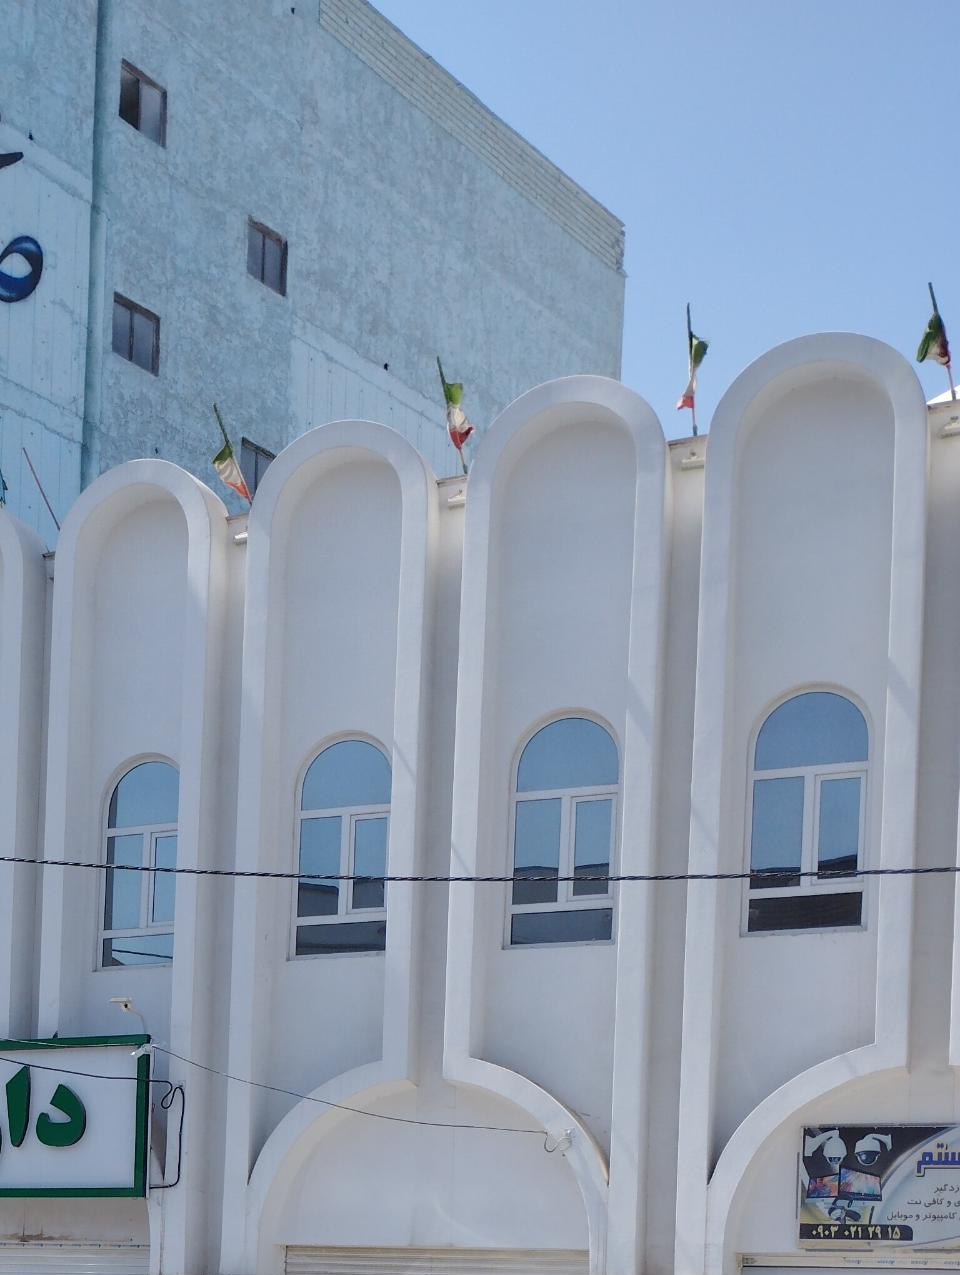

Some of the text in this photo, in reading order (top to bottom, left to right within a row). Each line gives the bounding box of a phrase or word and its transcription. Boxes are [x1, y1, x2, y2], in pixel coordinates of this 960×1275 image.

[924, 1198, 945, 1208] کافی
[886, 1211, 914, 1222] موبایل
[922, 1211, 958, 1223] کامپیوتر
[811, 1225, 839, 1239] ۰۹۰۳
[844, 1225, 862, 1239] ۰۲۱
[888, 1226, 901, 1240] ۱۵
